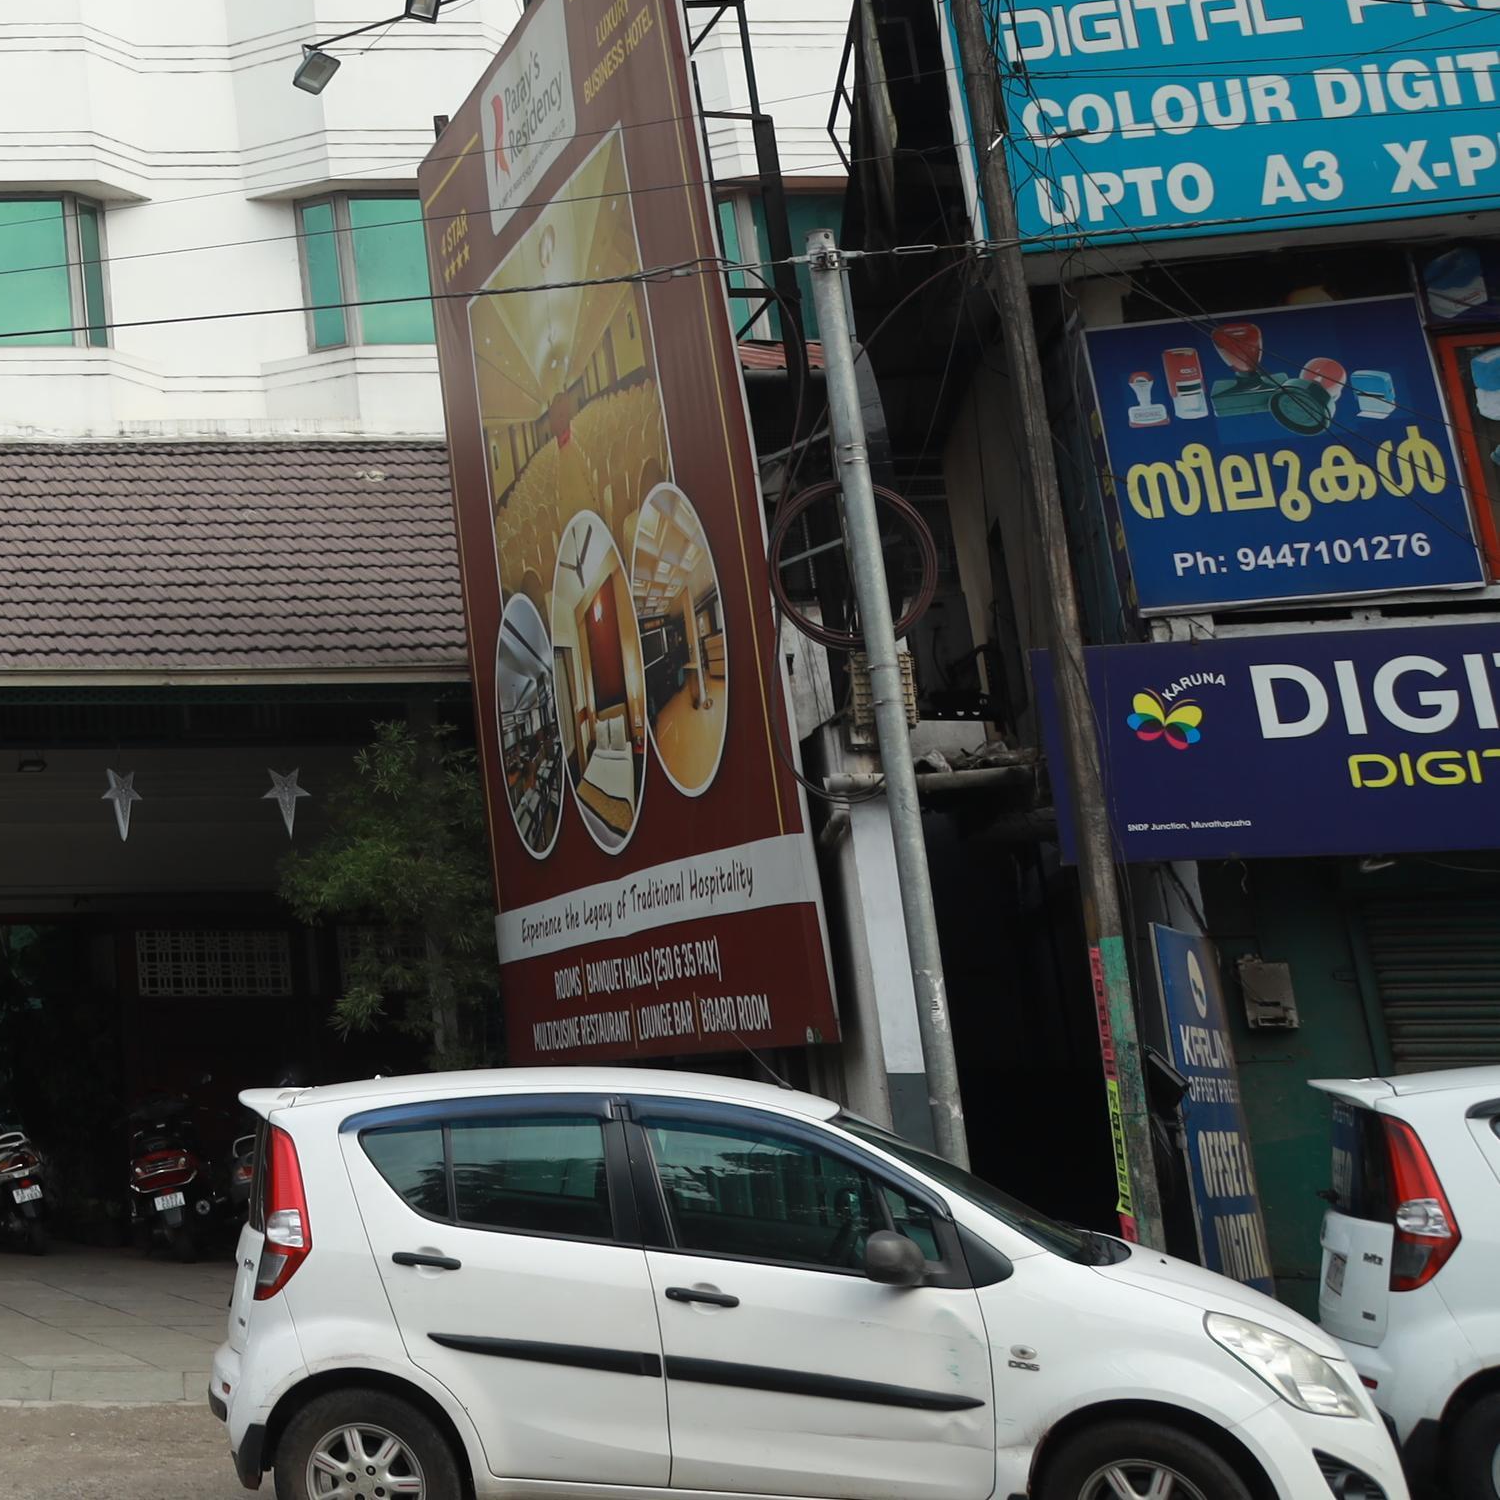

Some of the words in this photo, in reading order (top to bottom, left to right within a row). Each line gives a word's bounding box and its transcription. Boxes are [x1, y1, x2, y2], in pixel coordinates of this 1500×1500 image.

[503, 50, 541, 122] Paray's
[583, 45, 625, 105] BUSINESS
[626, 4, 654, 56] HOTEL
[508, 71, 563, 164] Residency
[1021, 74, 1297, 149] COLOUR
[1034, 161, 1214, 227] UPTO
[1261, 150, 1344, 207] A3
[1383, 134, 1500, 196] X-P
[448, 208, 469, 251] STAR
[1172, 550, 1228, 577] Ph:
[1236, 532, 1431, 572] 9447101276
[1162, 671, 1227, 701] KARUNA
[1249, 653, 1500, 740] DIGI
[521, 915, 562, 947] Experience
[565, 906, 580, 931] the
[583, 903, 612, 931] Legacy
[616, 893, 627, 920] of
[630, 880, 685, 915] Traditional
[689, 860, 753, 903] Hospitality
[554, 966, 582, 1000] ROOMS
[586, 958, 624, 994] BANQUET
[625, 951, 651, 989] HALLS
[651, 945, 672, 990] (250
[682, 942, 696, 978] 35
[581, 1009, 632, 1045] RESTAURANT
[636, 1001, 672, 1041] LOUNGE
[673, 999, 695, 1035] BAR
[700, 996, 736, 1033] BOARD
[737, 993, 772, 1031] ROOM
[1198, 1130, 1246, 1198] OFFSET
